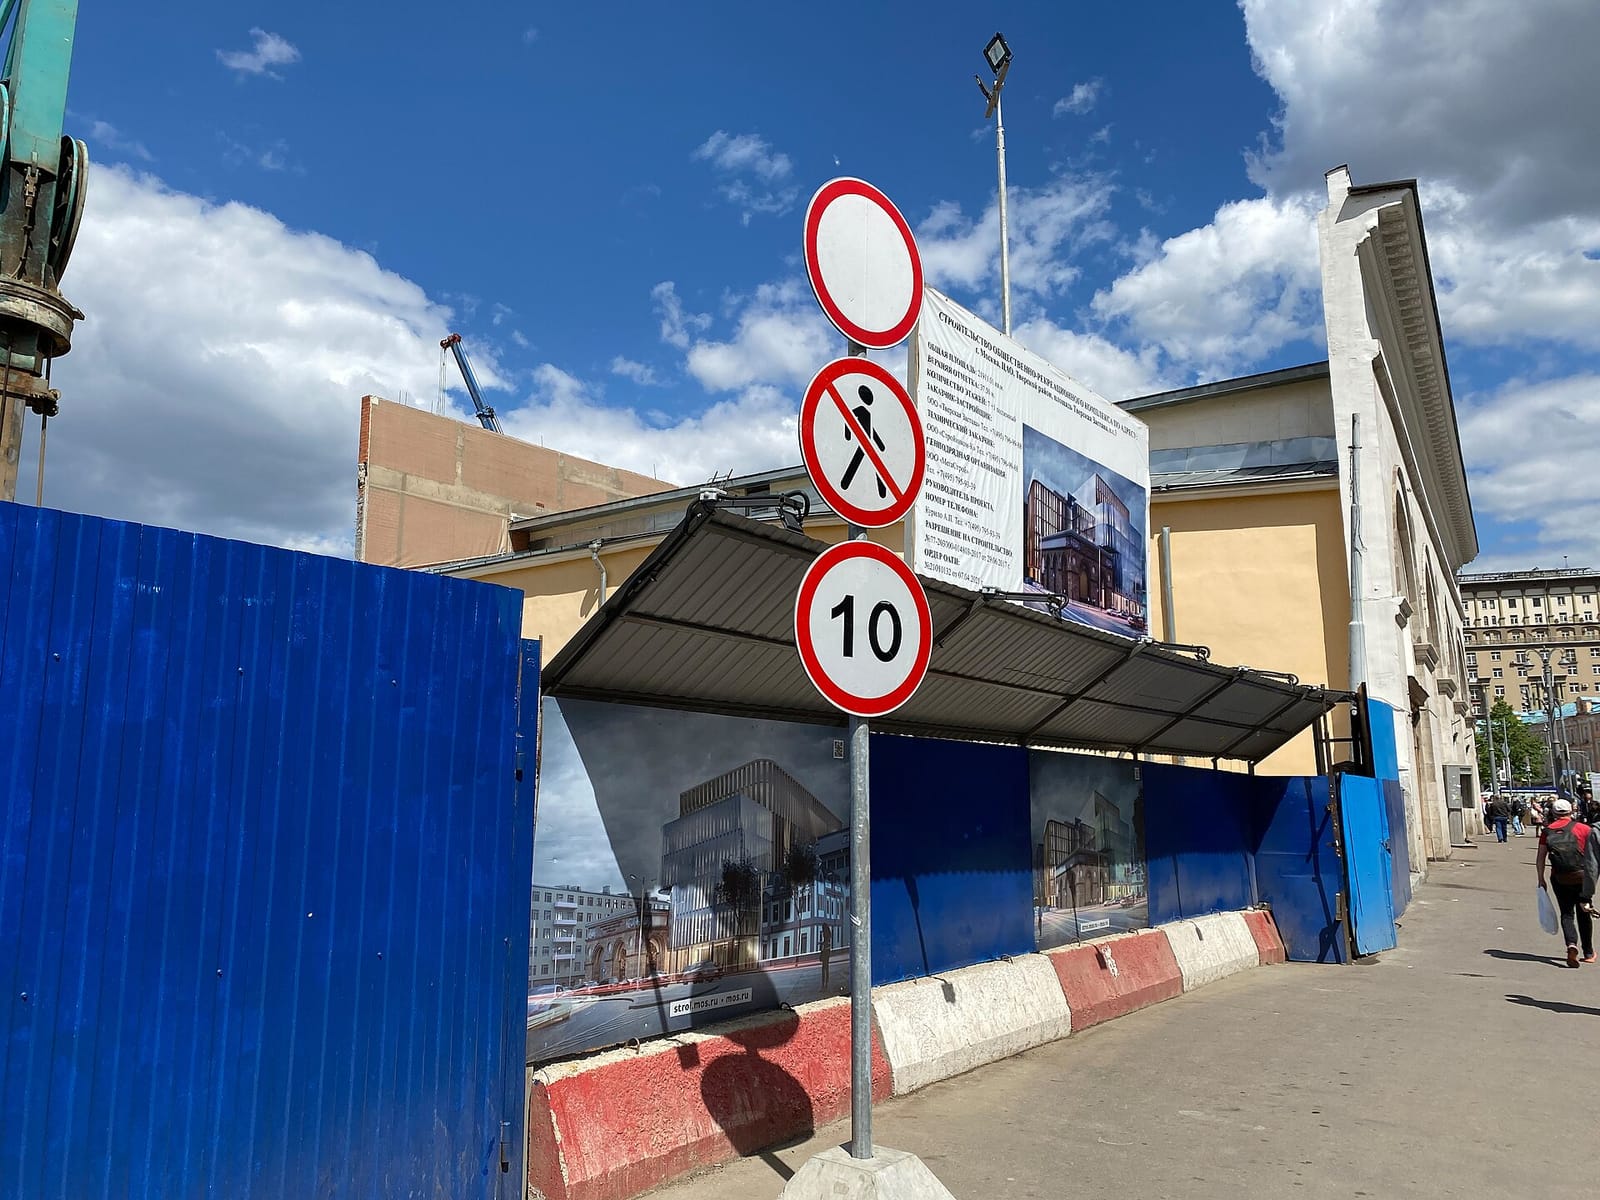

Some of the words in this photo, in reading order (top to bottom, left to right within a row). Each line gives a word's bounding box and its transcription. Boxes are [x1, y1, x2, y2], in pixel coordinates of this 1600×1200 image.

[938, 310, 992, 352] СТРОИТЕЛЬСТВО
[927, 341, 948, 360] ОБЩАЯ
[927, 354, 952, 375] ВЕРХНЯЯ
[926, 368, 964, 394] КОЛИЧЕСТВО
[1015, 370, 1037, 392] Тверской
[926, 395, 938, 408] ООО
[926, 422, 938, 435] ООО
[927, 408, 968, 435] ТЕХНИЧЕСКИЙ
[925, 436, 969, 463] ГЕНПОДРЯДНАЯ
[925, 477, 969, 502] РУКОВОДИТЕЛЬ
[925, 492, 946, 507] НОМЕР
[946, 500, 978, 519] ТЕЛЕФОНА:
[925, 519, 961, 539] РАЗРЕШЕНИЕ
[962, 533, 970, 543] НА
[923, 548, 943, 561] ОРДЕР
[831, 594, 903, 663] 10
[673, 999, 718, 1013] stroi.mos.ru
[725, 992, 749, 1003] mos.ru
